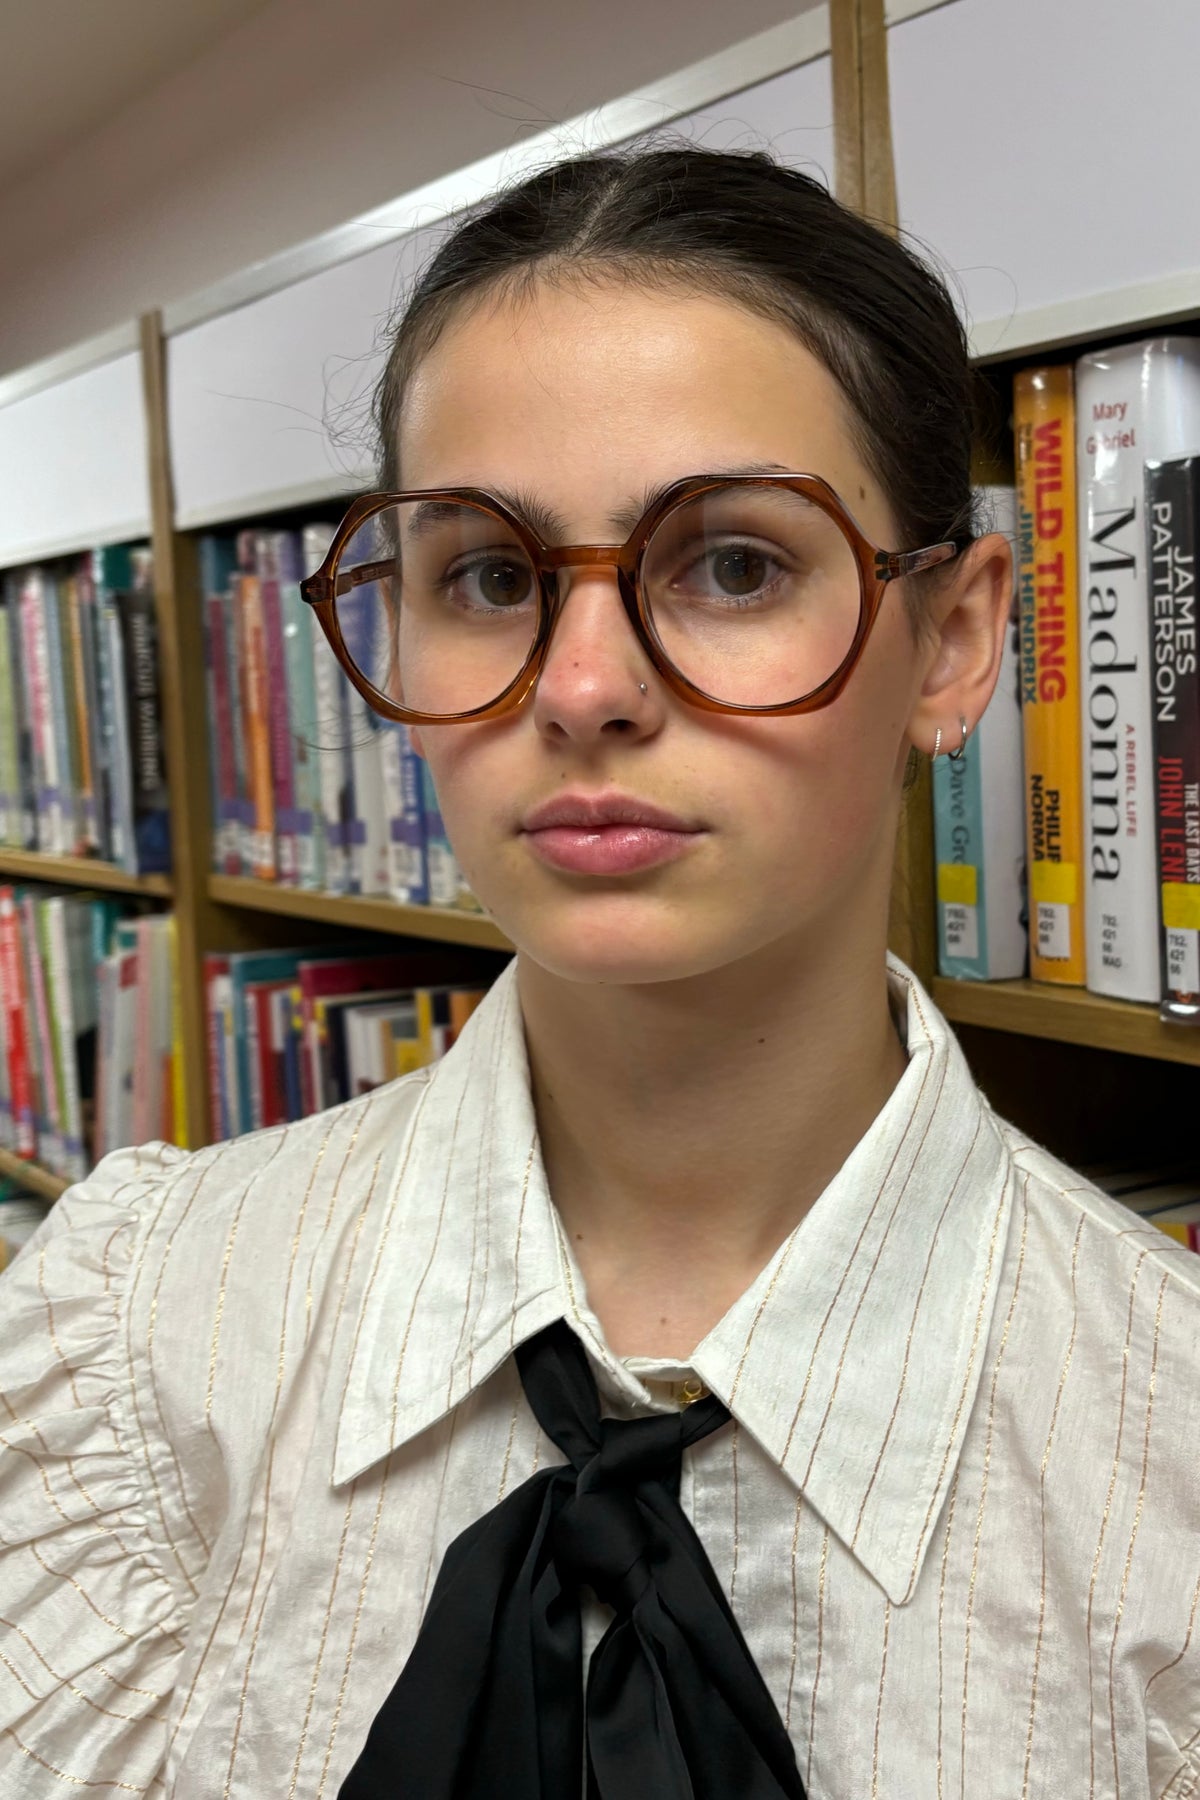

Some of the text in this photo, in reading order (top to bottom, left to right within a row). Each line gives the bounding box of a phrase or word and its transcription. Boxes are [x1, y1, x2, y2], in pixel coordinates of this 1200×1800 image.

[1092, 403, 1127, 421] Mary
[1020, 504, 1034, 563] JIMI
[1035, 417, 1066, 703] WILD THING
[1022, 573, 1036, 703] HENDRIX
[1152, 502, 1176, 721] PATTERSON
[1174, 546, 1196, 675] JAMES
[1089, 496, 1138, 886] Madonna
[1125, 724, 1137, 837] A REBEL LIFE
[1158, 756, 1183, 817] JOHN
[1184, 782, 1200, 883] THE LAST DAYS
